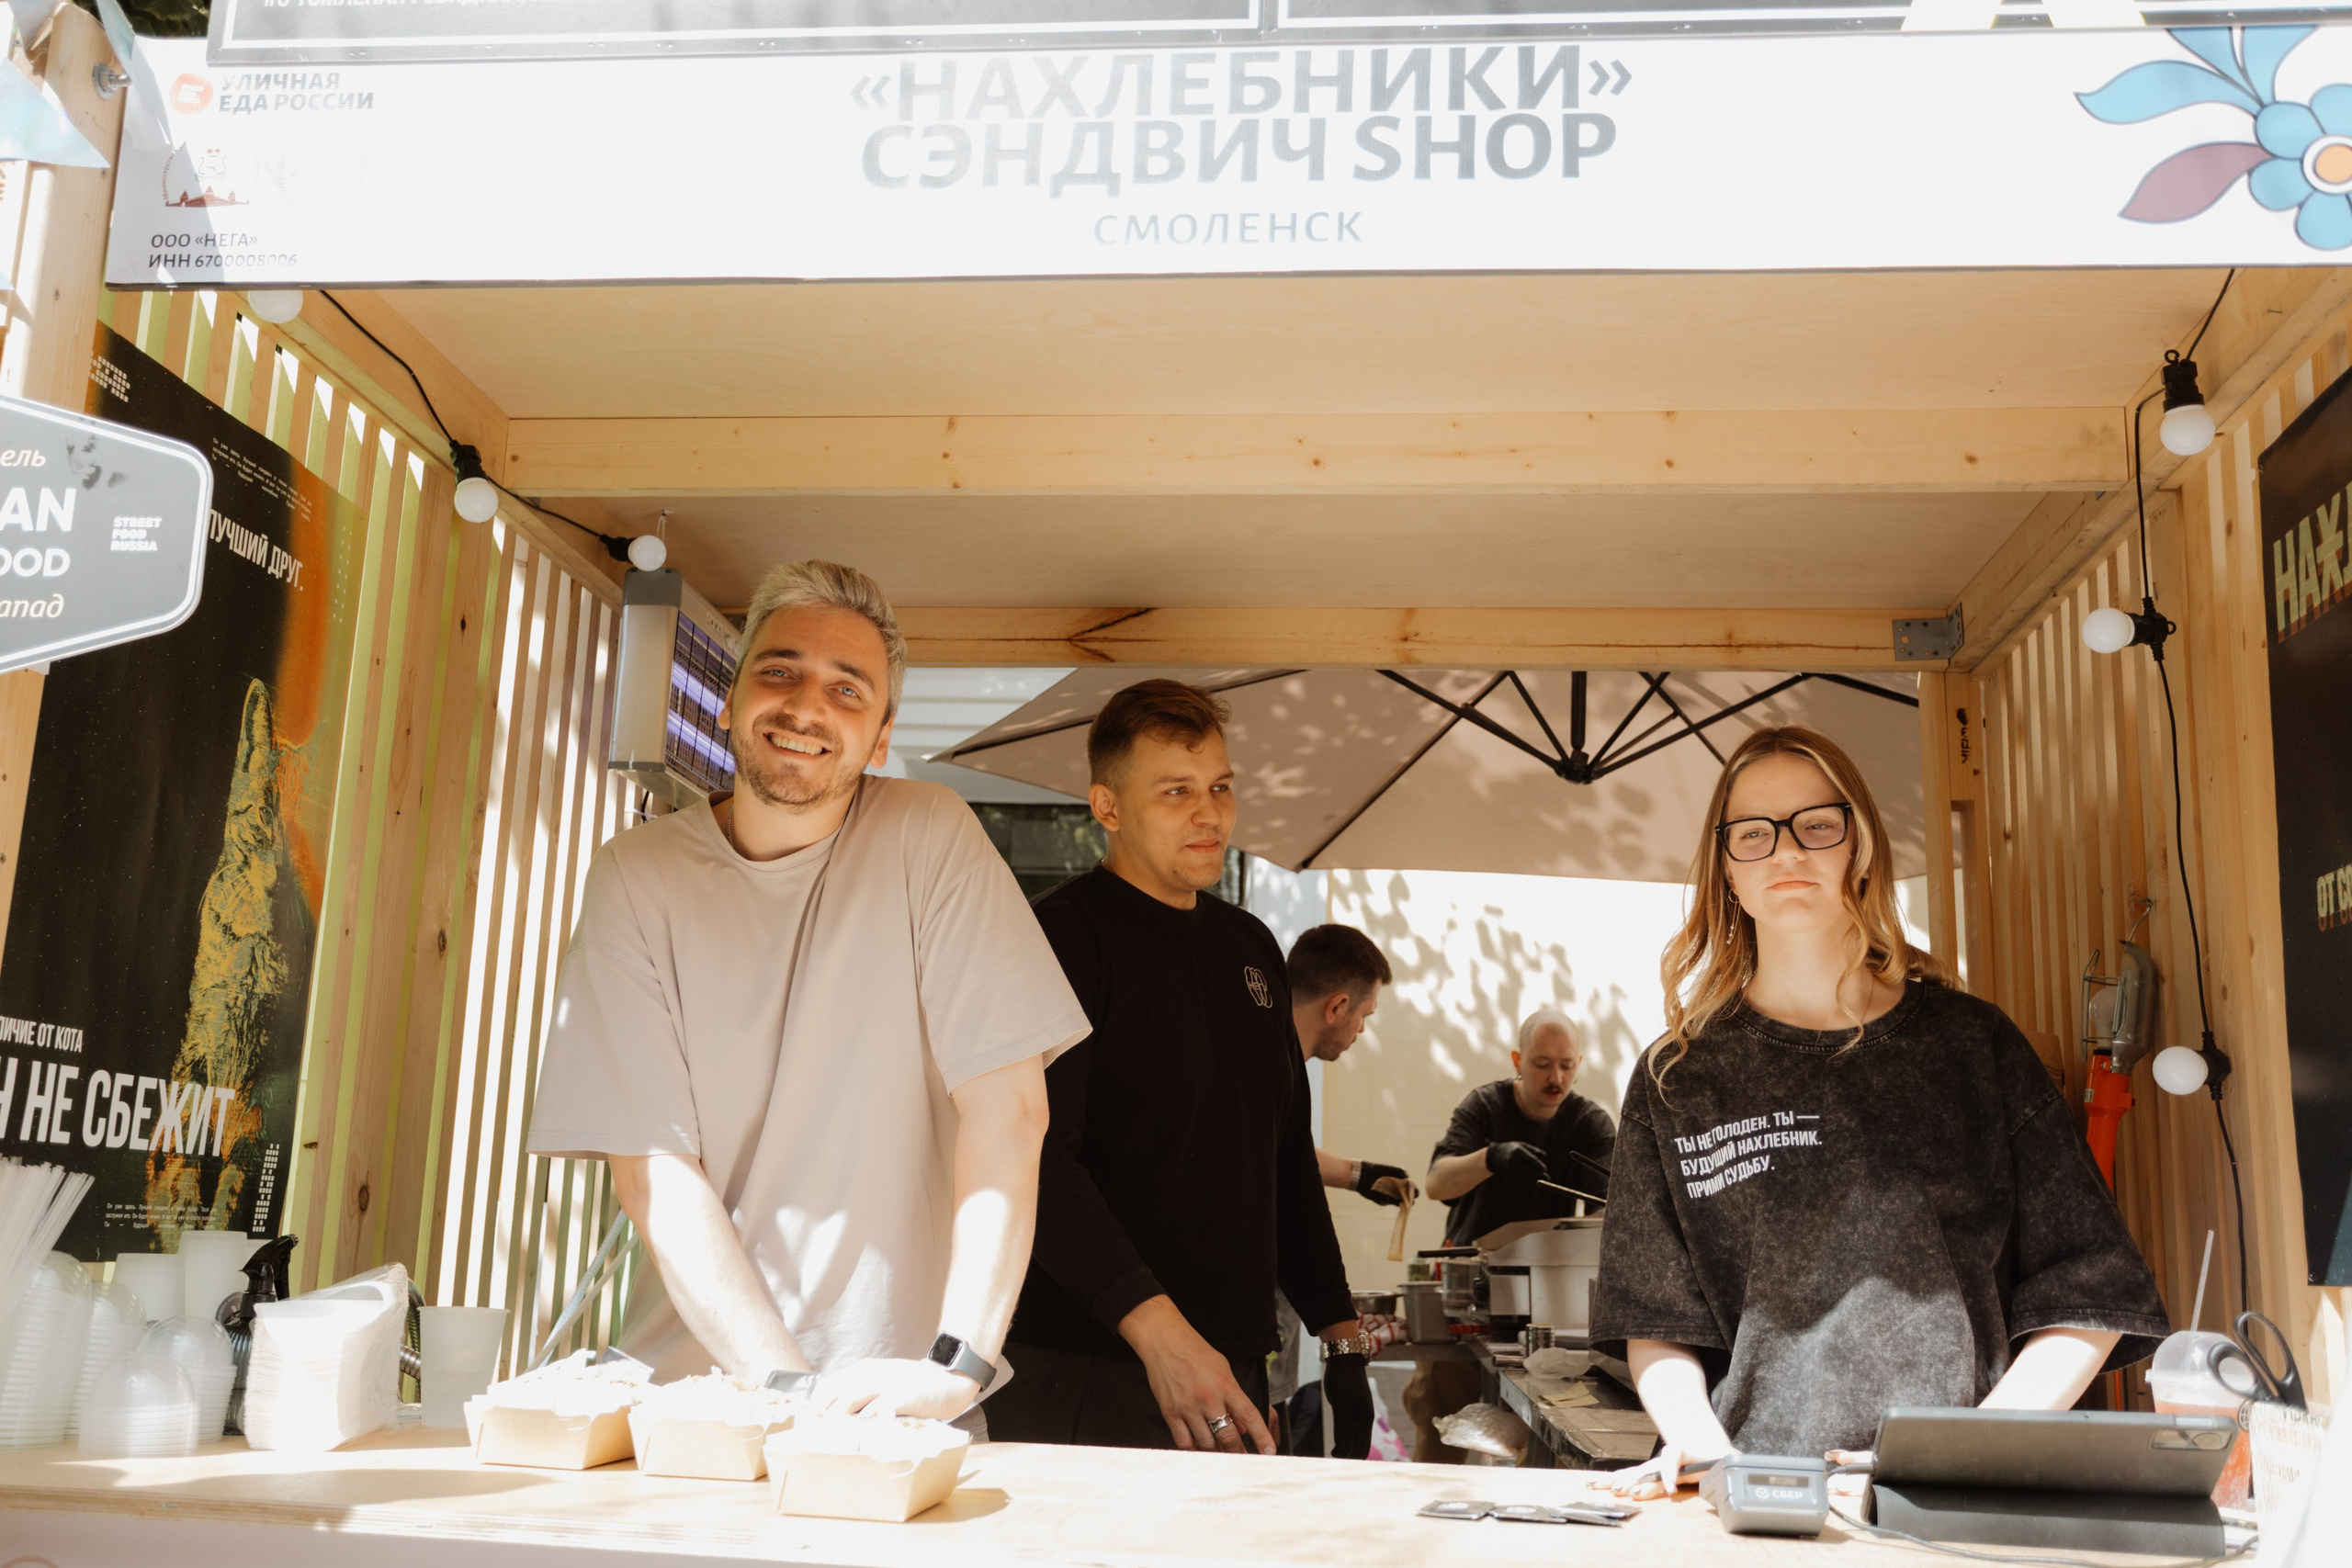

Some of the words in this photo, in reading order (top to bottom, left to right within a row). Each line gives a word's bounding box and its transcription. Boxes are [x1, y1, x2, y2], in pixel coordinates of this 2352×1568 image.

[221, 73, 340, 91] УЛИЧНАЯ
[850, 45, 1633, 121] «НАХЛЕБНИКИ»
[219, 95, 268, 115] ЕДА
[274, 93, 374, 111] РОССИИ
[862, 118, 1326, 199] СЭНДВИЧ
[1352, 113, 1617, 183] SHOP
[151, 233, 191, 248] ООО
[195, 233, 257, 248] «НЕГА»
[1093, 211, 1363, 245] СМОЛЕНСК
[149, 254, 191, 268] ИНН
[0, 449, 46, 468] ель
[0, 488, 76, 531] AN
[114, 516, 163, 527] STREET
[110, 540, 158, 551] RUSSIA
[112, 528, 147, 539] FOOD
[267, 545, 303, 592] ДРУГ.
[2317, 872, 2335, 919] ОТ
[37, 1022, 55, 1047] ОТ
[54, 1026, 84, 1053] КОТА
[19, 1060, 80, 1145] НЕ
[82, 1069, 236, 1157] СБЕЖИТ
[1674, 1137, 1697, 1154] ТЫ
[1697, 1132, 1713, 1150] НЕ
[1773, 1111, 1794, 1127] ТЫ
[1680, 1142, 1736, 1177] БУДУЩИЙ
[1737, 1131, 1823, 1156] НАХЛЕБНИК.
[1687, 1173, 1725, 1199] ПРИМИ
[1724, 1156, 1775, 1186] СУДЬБУ.
[1771, 1489, 1804, 1499] СБЕР
